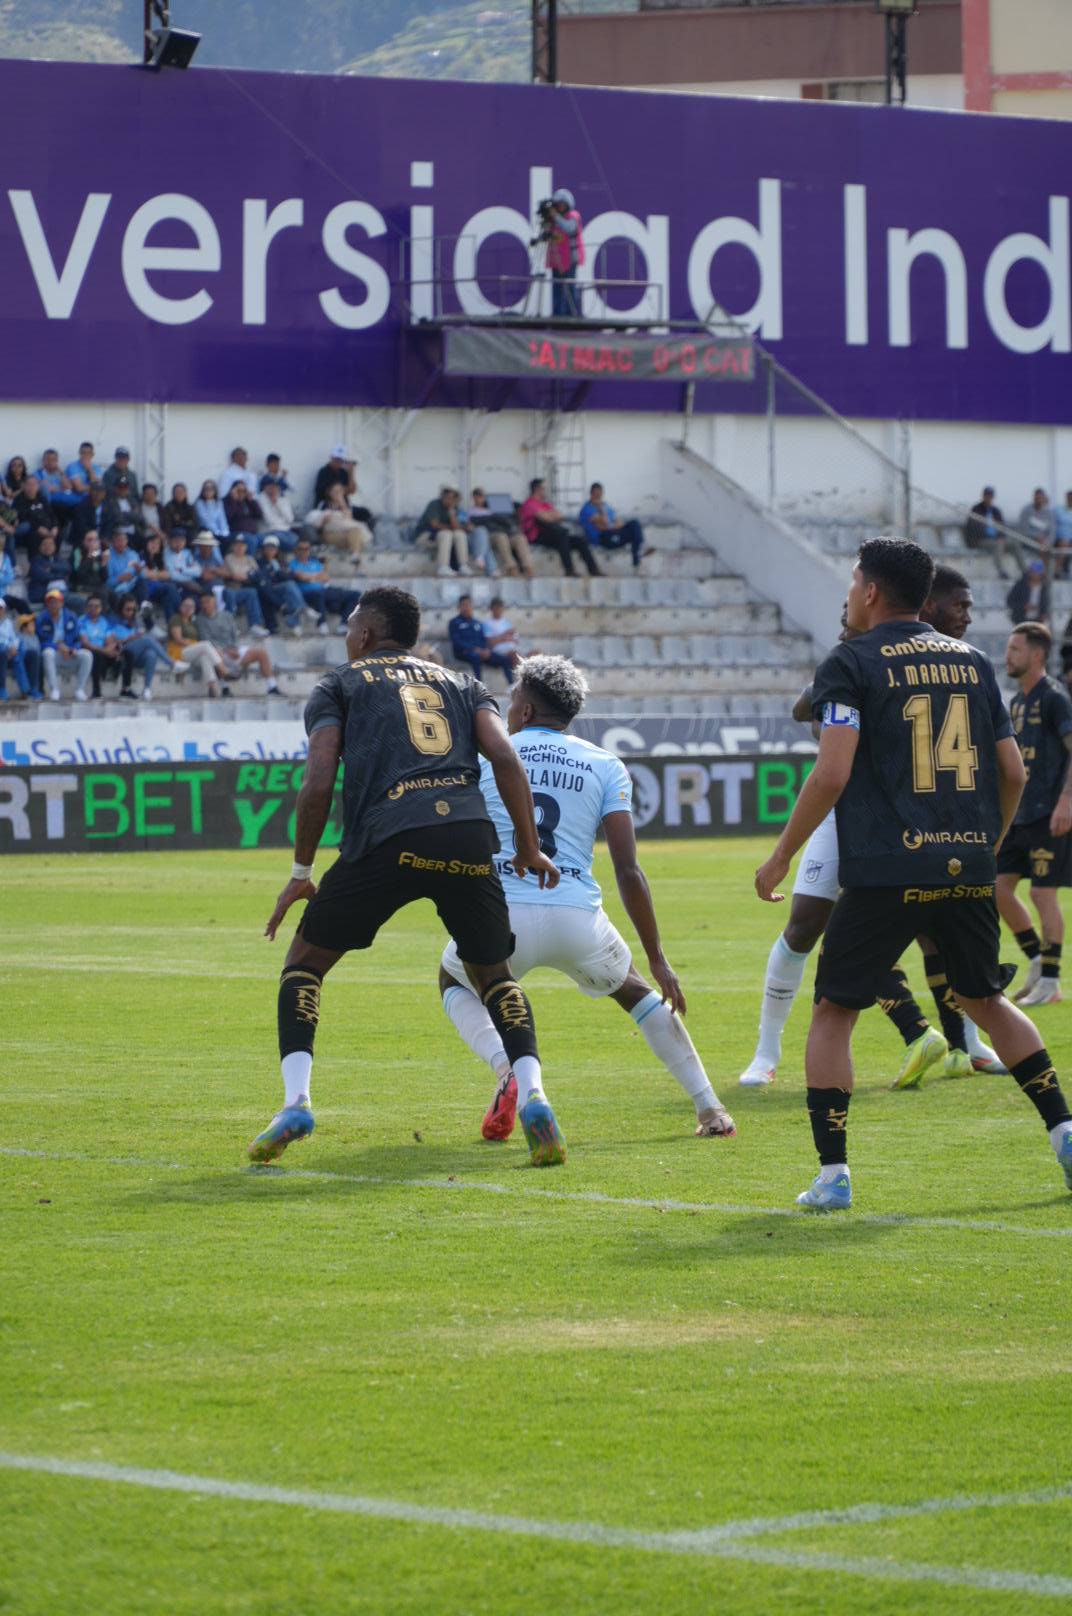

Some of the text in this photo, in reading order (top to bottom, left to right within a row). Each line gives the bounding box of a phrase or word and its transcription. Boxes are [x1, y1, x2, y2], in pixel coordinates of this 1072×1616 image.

[844, 184, 1071, 354] Ind
[880, 637, 970, 657] ambacar
[362, 669, 381, 683] B.
[887, 663, 980, 687] J. MARRUFO
[400, 682, 453, 756] 6
[519, 743, 568, 756] BANCO
[903, 693, 978, 793] 14
[519, 752, 594, 774] PICHINCHA
[525, 768, 585, 793] LAVIJO
[924, 831, 988, 844] MIRACLE
[447, 860, 491, 876] STORE
[952, 885, 994, 898] STORE
